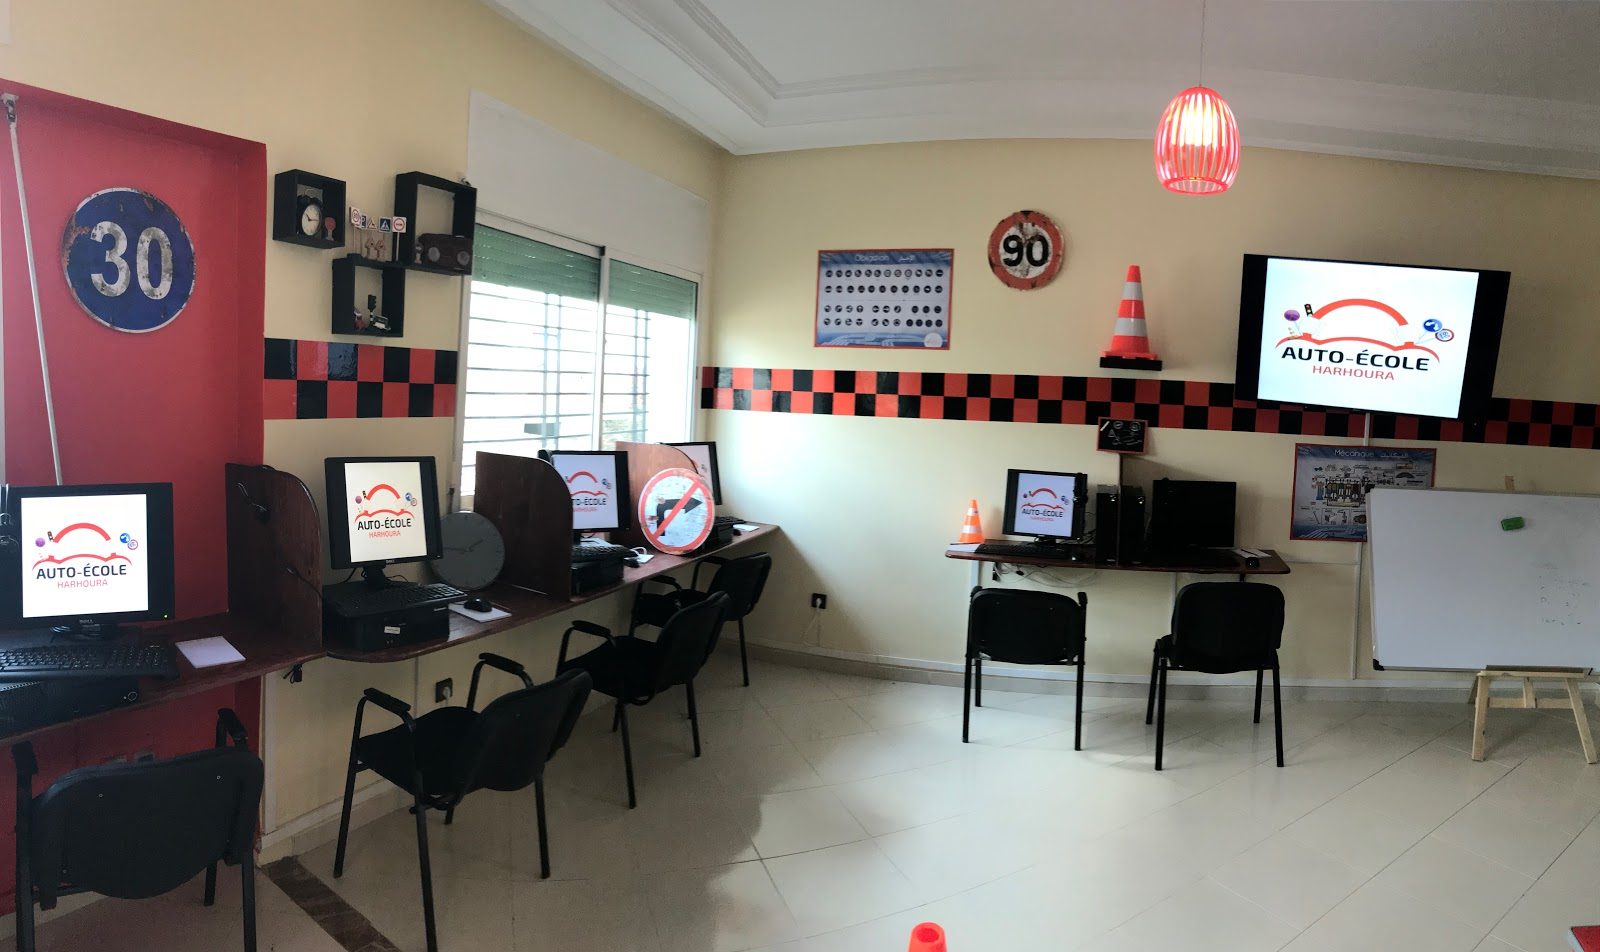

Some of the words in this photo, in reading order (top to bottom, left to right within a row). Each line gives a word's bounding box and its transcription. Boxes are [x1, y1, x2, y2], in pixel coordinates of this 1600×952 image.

[1003, 234, 1049, 267] 90
[90, 220, 173, 300] 30
[1281, 346, 1430, 371] AUTO-ÉCOLE
[1312, 365, 1394, 381] HARHOURA
[1334, 449, 1375, 459] Mécanique
[1021, 509, 1064, 518] AUTO-ÉCOLE
[357, 517, 412, 531] AUTO-ÉCOLE
[36, 563, 127, 580] AUTO-ÉCOLE
[57, 579, 109, 589] HARHOURA
